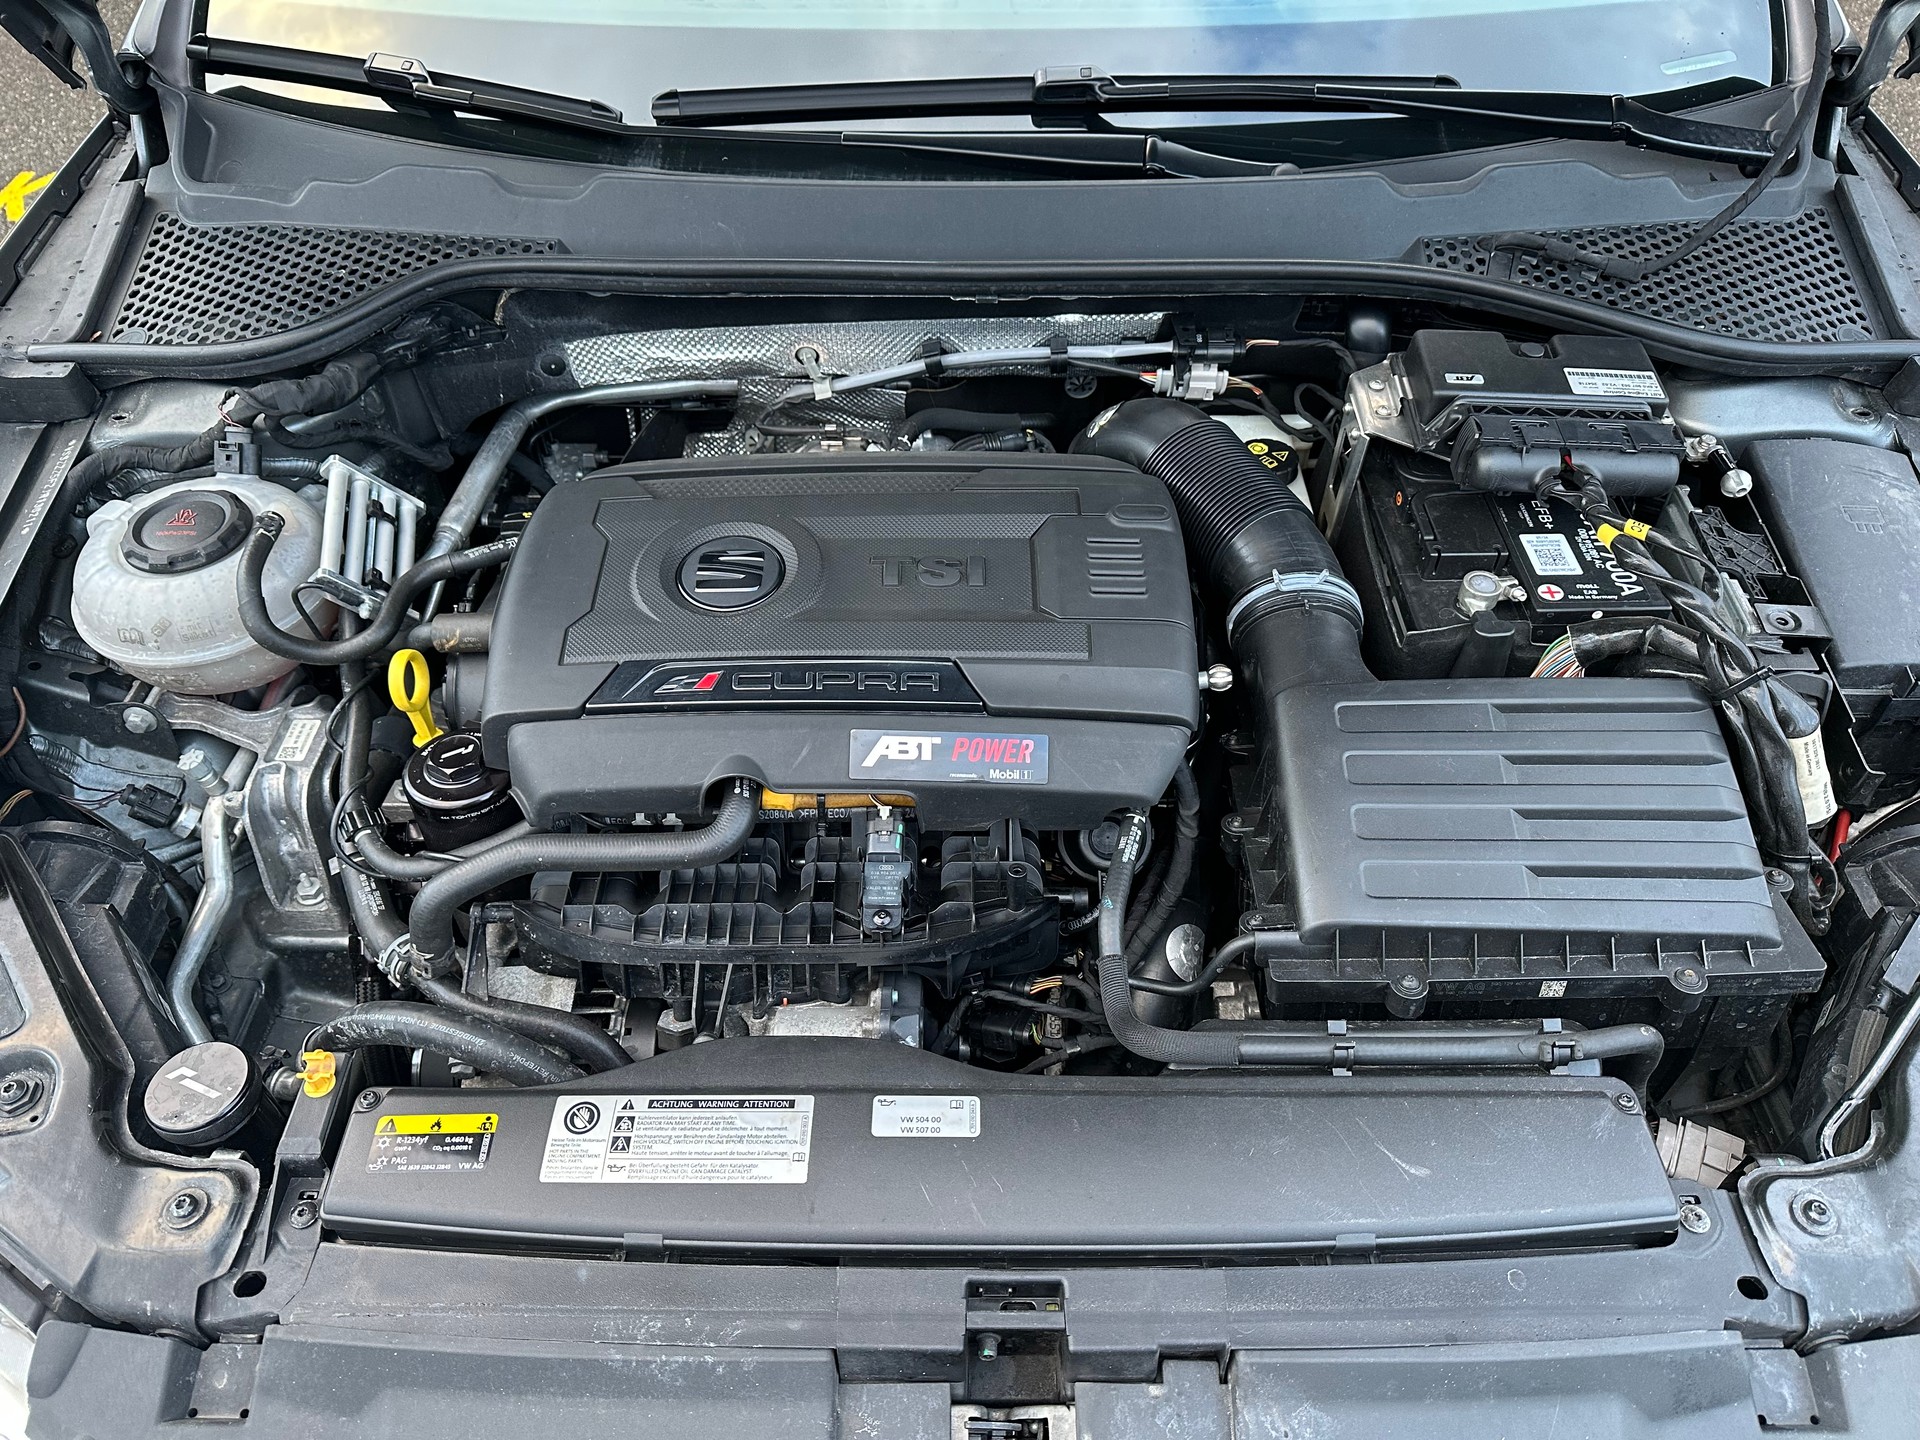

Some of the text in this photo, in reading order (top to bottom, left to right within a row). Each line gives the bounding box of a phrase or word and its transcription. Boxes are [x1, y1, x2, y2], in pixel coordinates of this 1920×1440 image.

[869, 556, 986, 588] TSI
[732, 671, 940, 693] CUPRA
[861, 735, 1034, 767] ABT POWER
[989, 769, 1020, 779] Mobil
[758, 810, 794, 820] S20841A
[430, 1024, 487, 1046] BRIDGESTONE
[396, 1136, 429, 1145] R-1234yf
